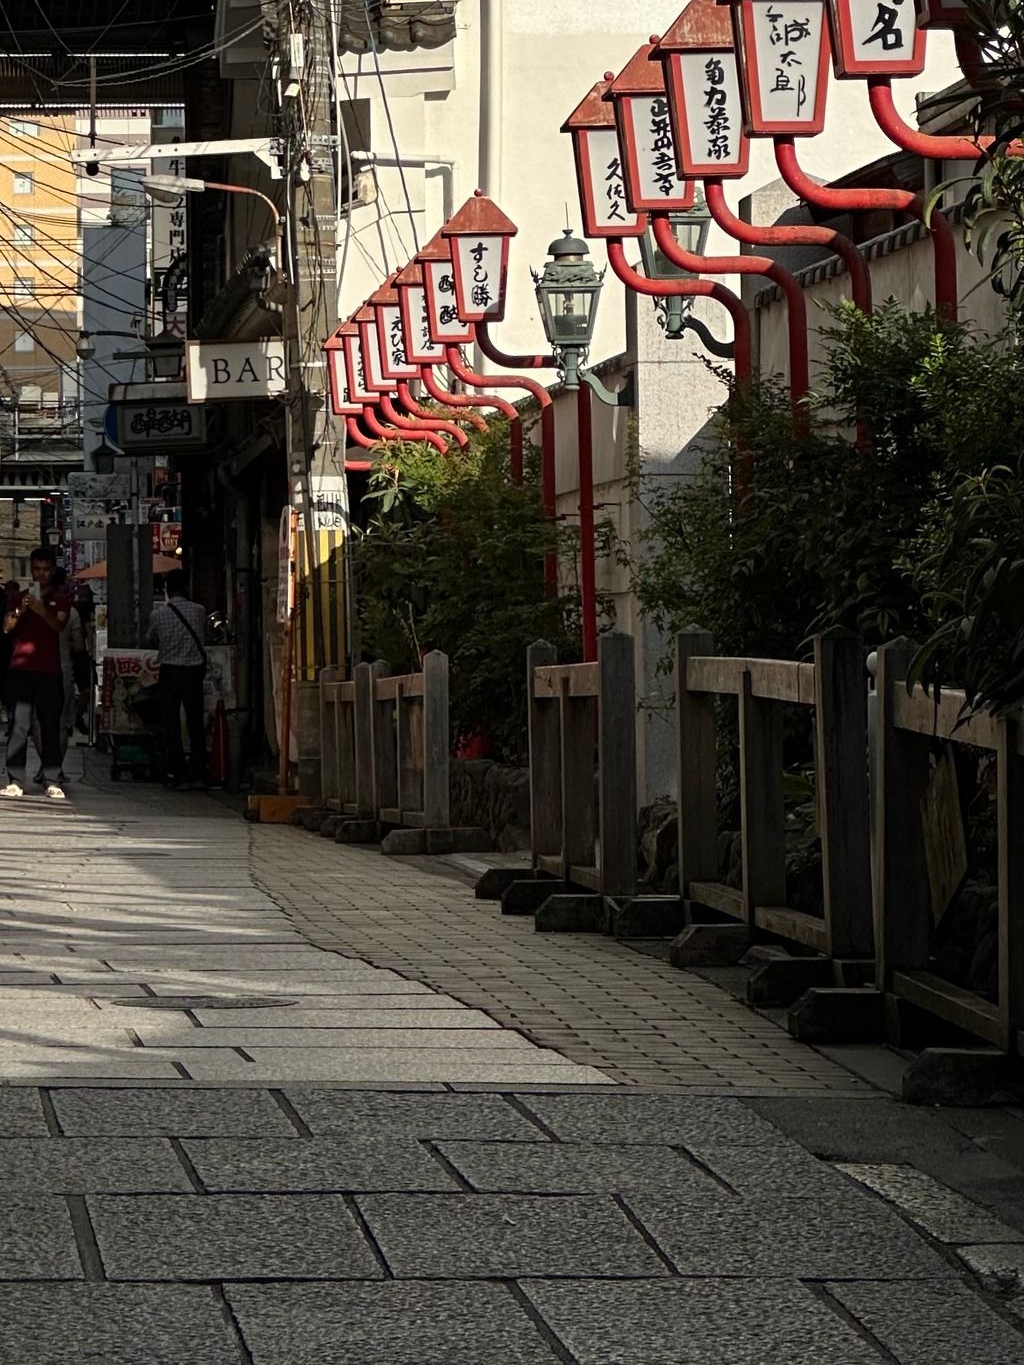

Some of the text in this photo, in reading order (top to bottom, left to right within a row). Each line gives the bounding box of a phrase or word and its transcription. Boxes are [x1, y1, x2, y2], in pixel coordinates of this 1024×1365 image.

[766, 5, 812, 117] 誠太郎
[605, 157, 626, 221] 久佐久
[470, 242, 493, 307] すし勝
[212, 357, 286, 384] BAR
